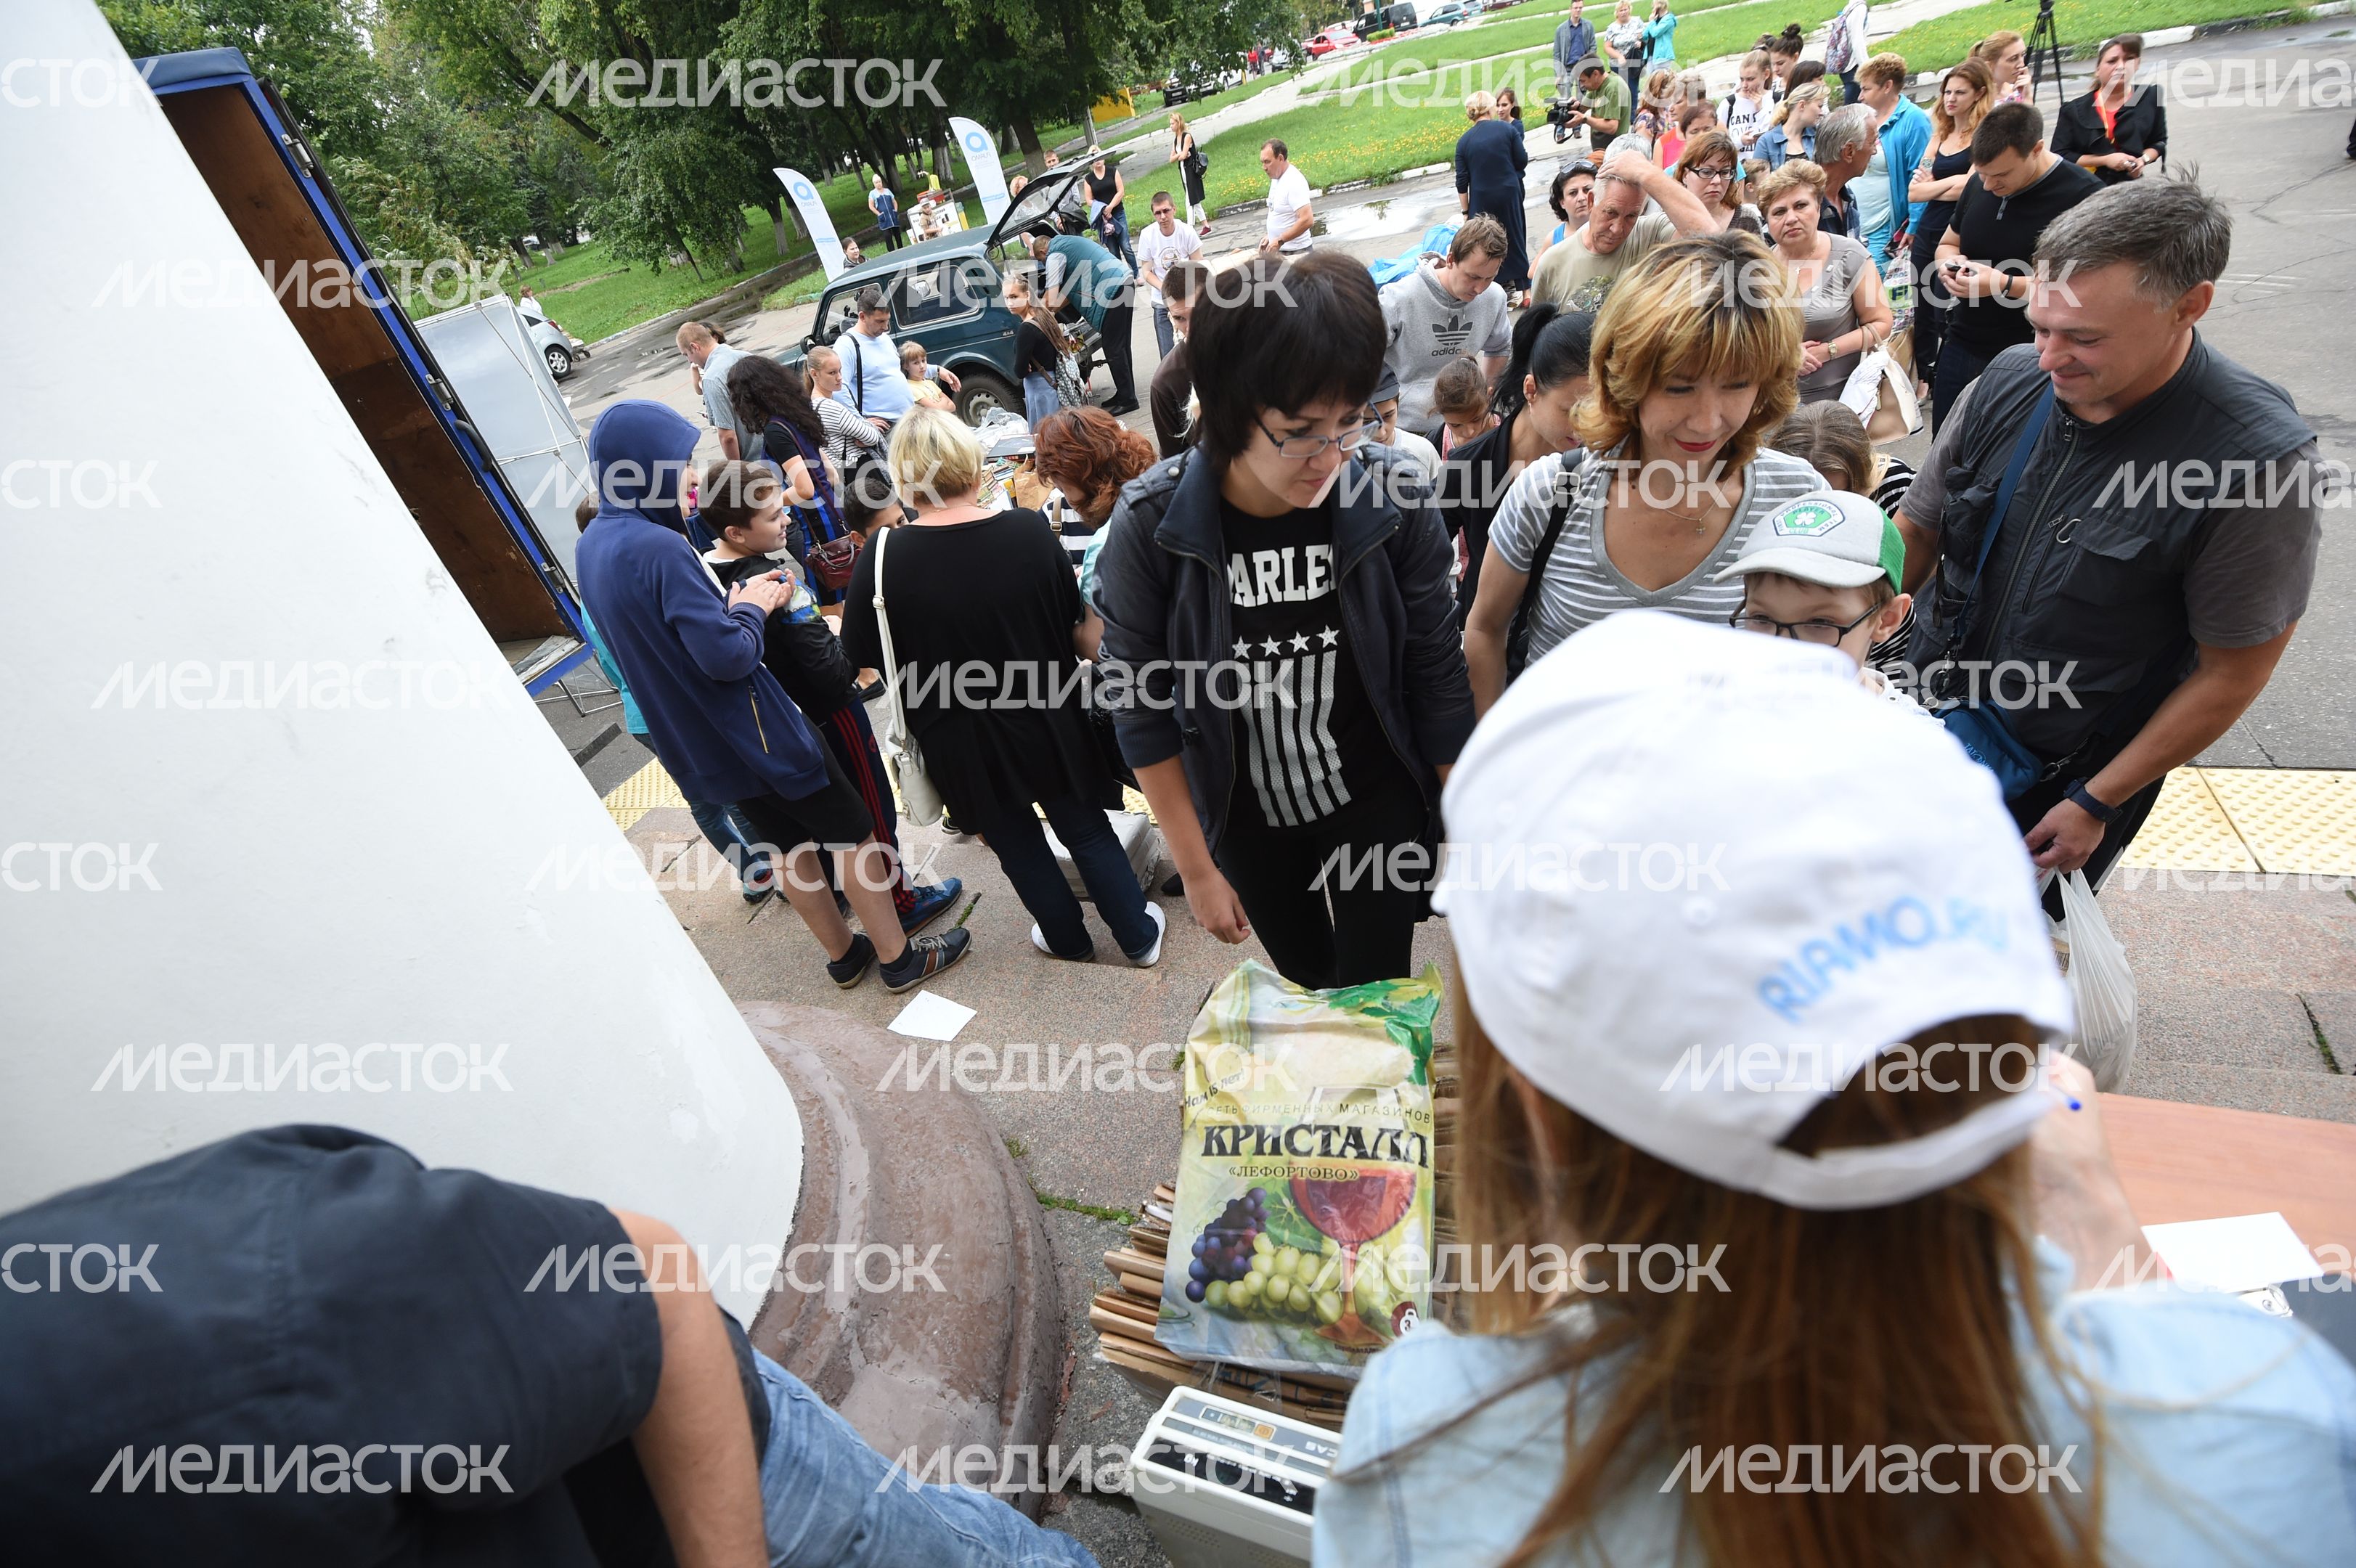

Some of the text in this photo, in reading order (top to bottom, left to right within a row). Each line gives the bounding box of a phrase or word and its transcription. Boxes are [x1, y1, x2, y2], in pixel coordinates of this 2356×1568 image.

[1431, 347, 1462, 356] adida
[1207, 1103, 1430, 1123] СЕТЬ ФИРМЕННЫХ МАГАЗИНОВ
[1201, 1124, 1429, 1168] КРИСТАЛЛ
[1228, 1166, 1358, 1180] «ЛЕФОРТОВО»
